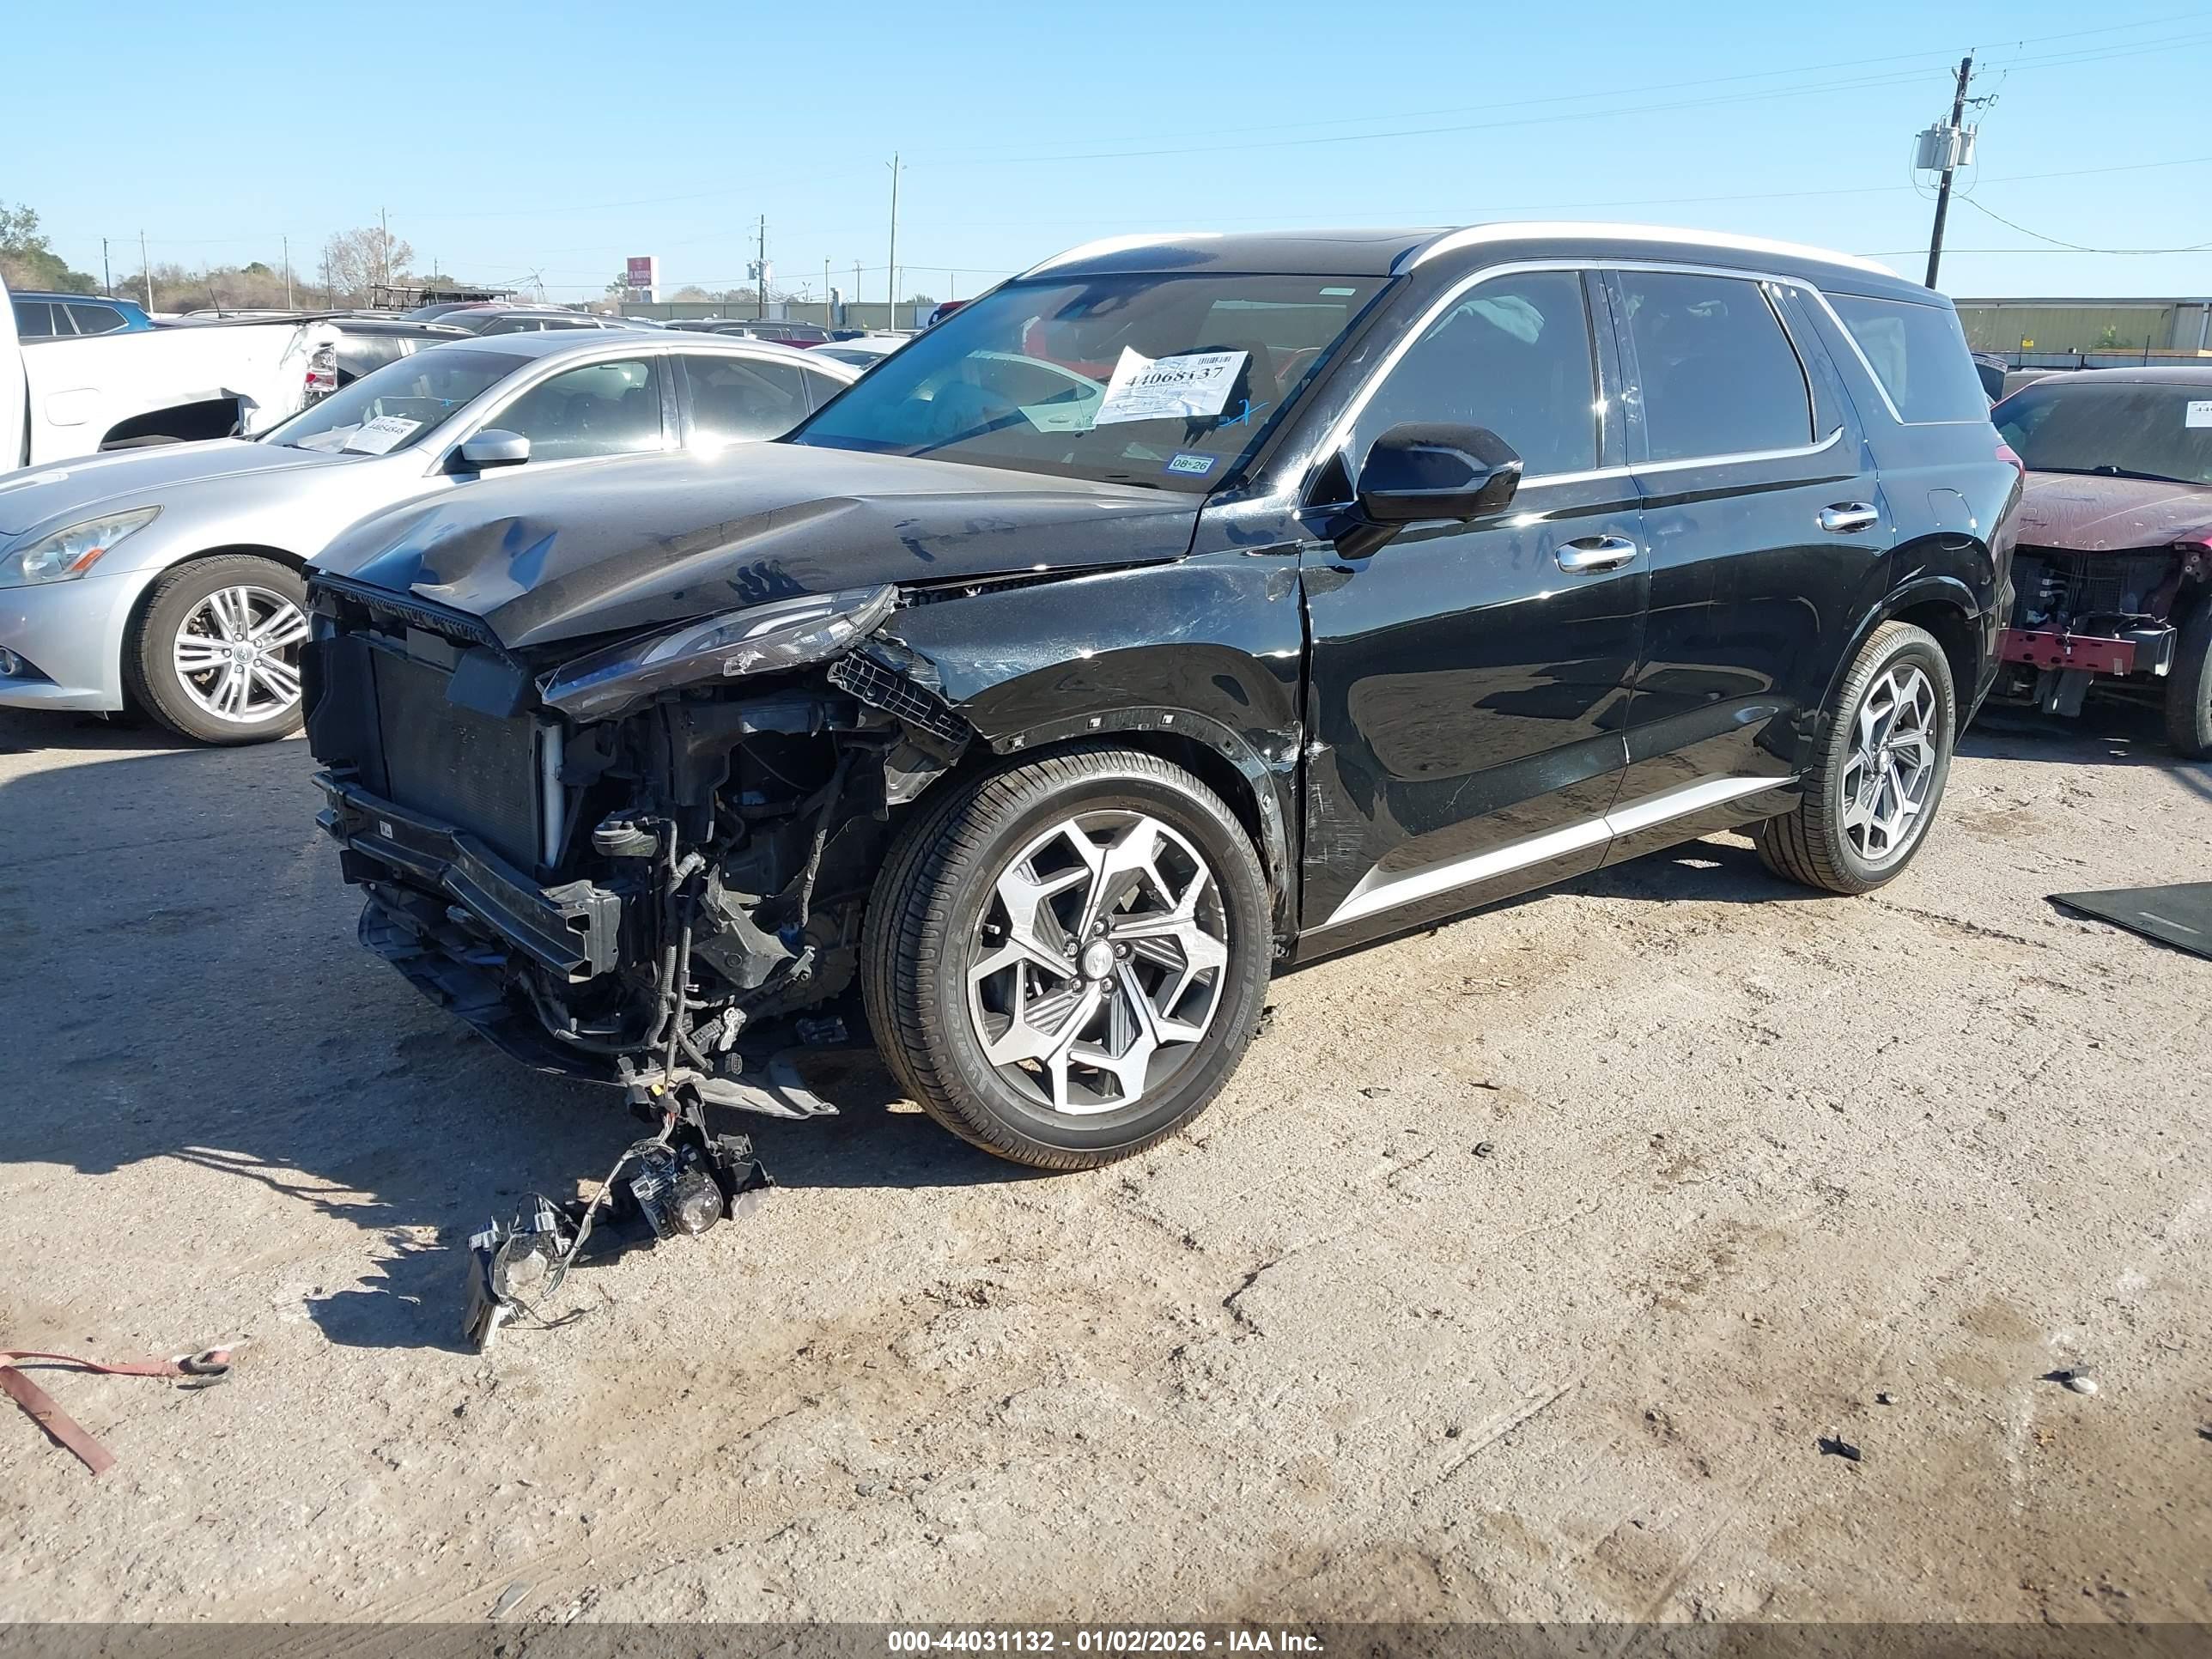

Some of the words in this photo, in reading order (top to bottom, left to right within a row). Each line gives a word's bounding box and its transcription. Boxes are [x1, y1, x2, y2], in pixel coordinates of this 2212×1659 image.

[1125, 367, 1224, 386] 44068137
[1173, 459, 1189, 468] 08
[1192, 461, 1208, 470] 26
